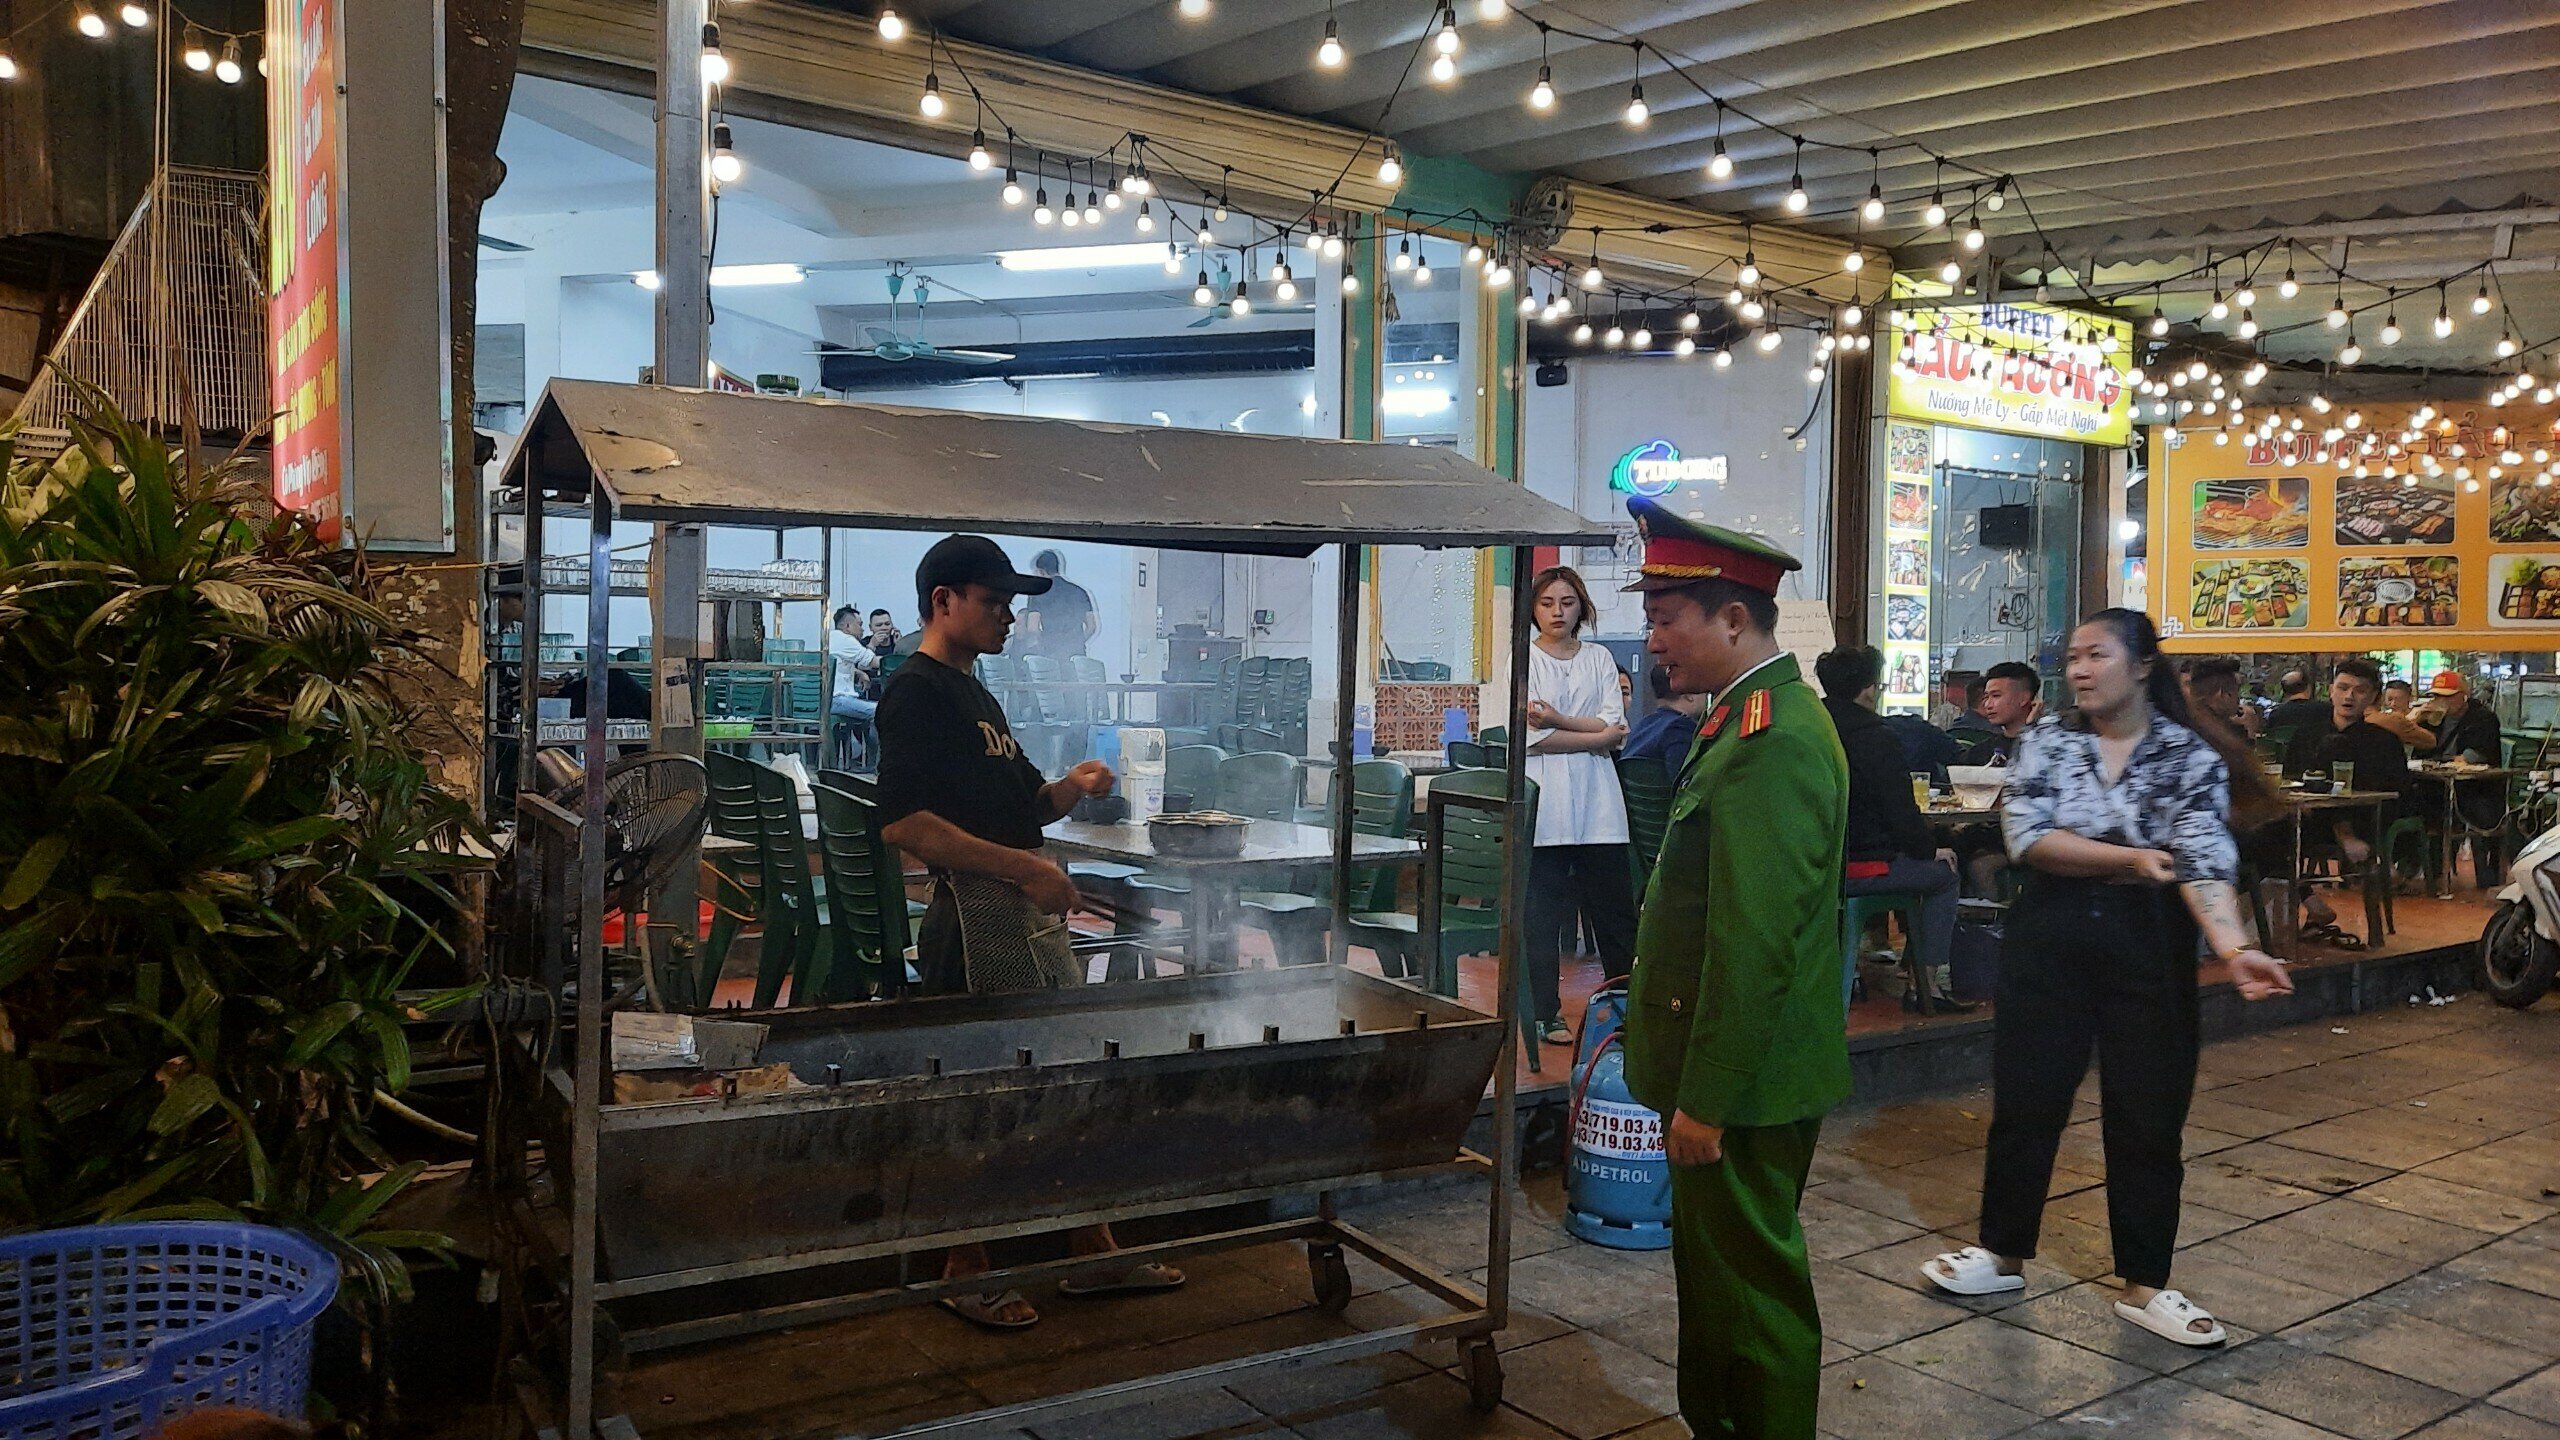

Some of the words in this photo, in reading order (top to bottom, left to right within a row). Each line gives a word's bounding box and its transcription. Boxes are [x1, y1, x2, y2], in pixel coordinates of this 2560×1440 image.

[1981, 303, 2055, 339] BUFFET
[1928, 389, 1970, 417] Nướng
[1973, 396, 1993, 416] Mê
[1995, 399, 2010, 422] Ly
